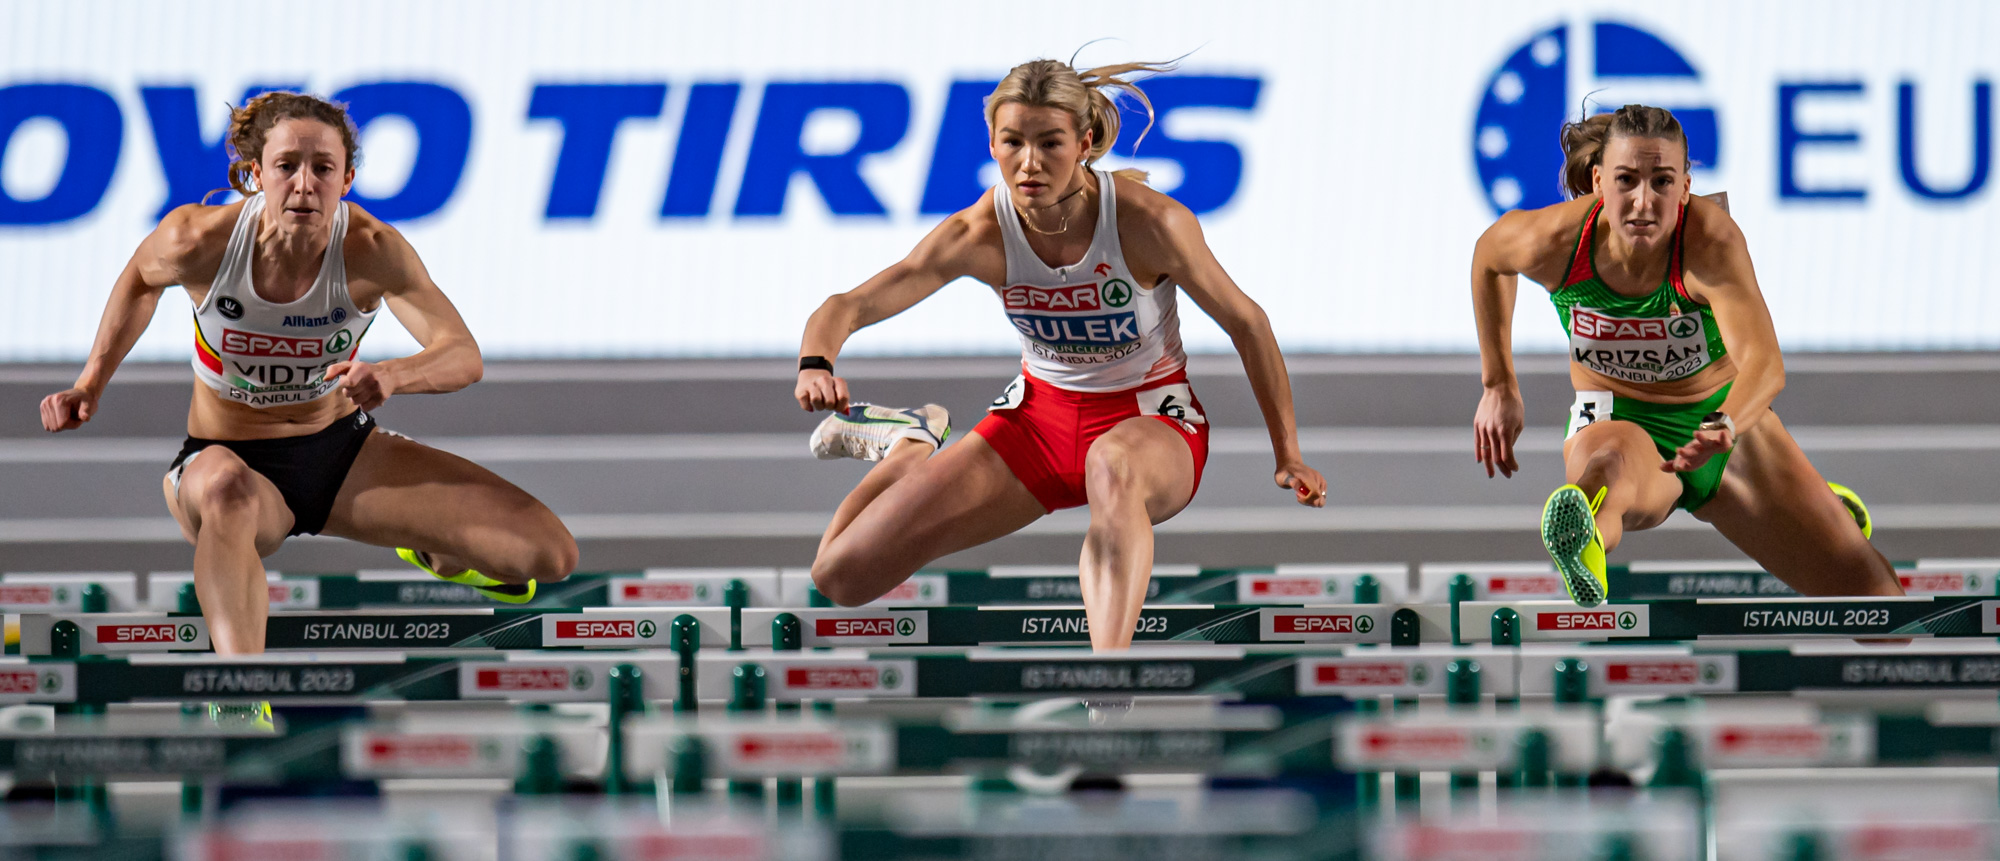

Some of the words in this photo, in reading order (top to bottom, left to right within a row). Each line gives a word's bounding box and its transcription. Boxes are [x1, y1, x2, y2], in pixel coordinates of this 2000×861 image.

[1005, 287, 1098, 309] SPAR
[282, 315, 330, 328] Allianz
[1011, 316, 1140, 342] SULEK
[1576, 315, 1664, 338] SPAR
[225, 333, 320, 356] SPAR
[1665, 356, 1702, 381] 2023
[309, 375, 340, 399] 202
[1157, 394, 1186, 420] 6
[835, 620, 892, 634] SPAR
[1022, 617, 1089, 633] ISTANB
[1134, 616, 1168, 633] 023
[1293, 617, 1351, 631] SPAR
[1556, 614, 1614, 629] SPAR
[1743, 610, 1839, 628] ISTANBUL
[1843, 609, 1889, 626] 2023
[117, 626, 174, 641] SPAR
[304, 623, 399, 640] ISTANBUL
[403, 623, 450, 640] 2023
[576, 622, 634, 636] SPAR
